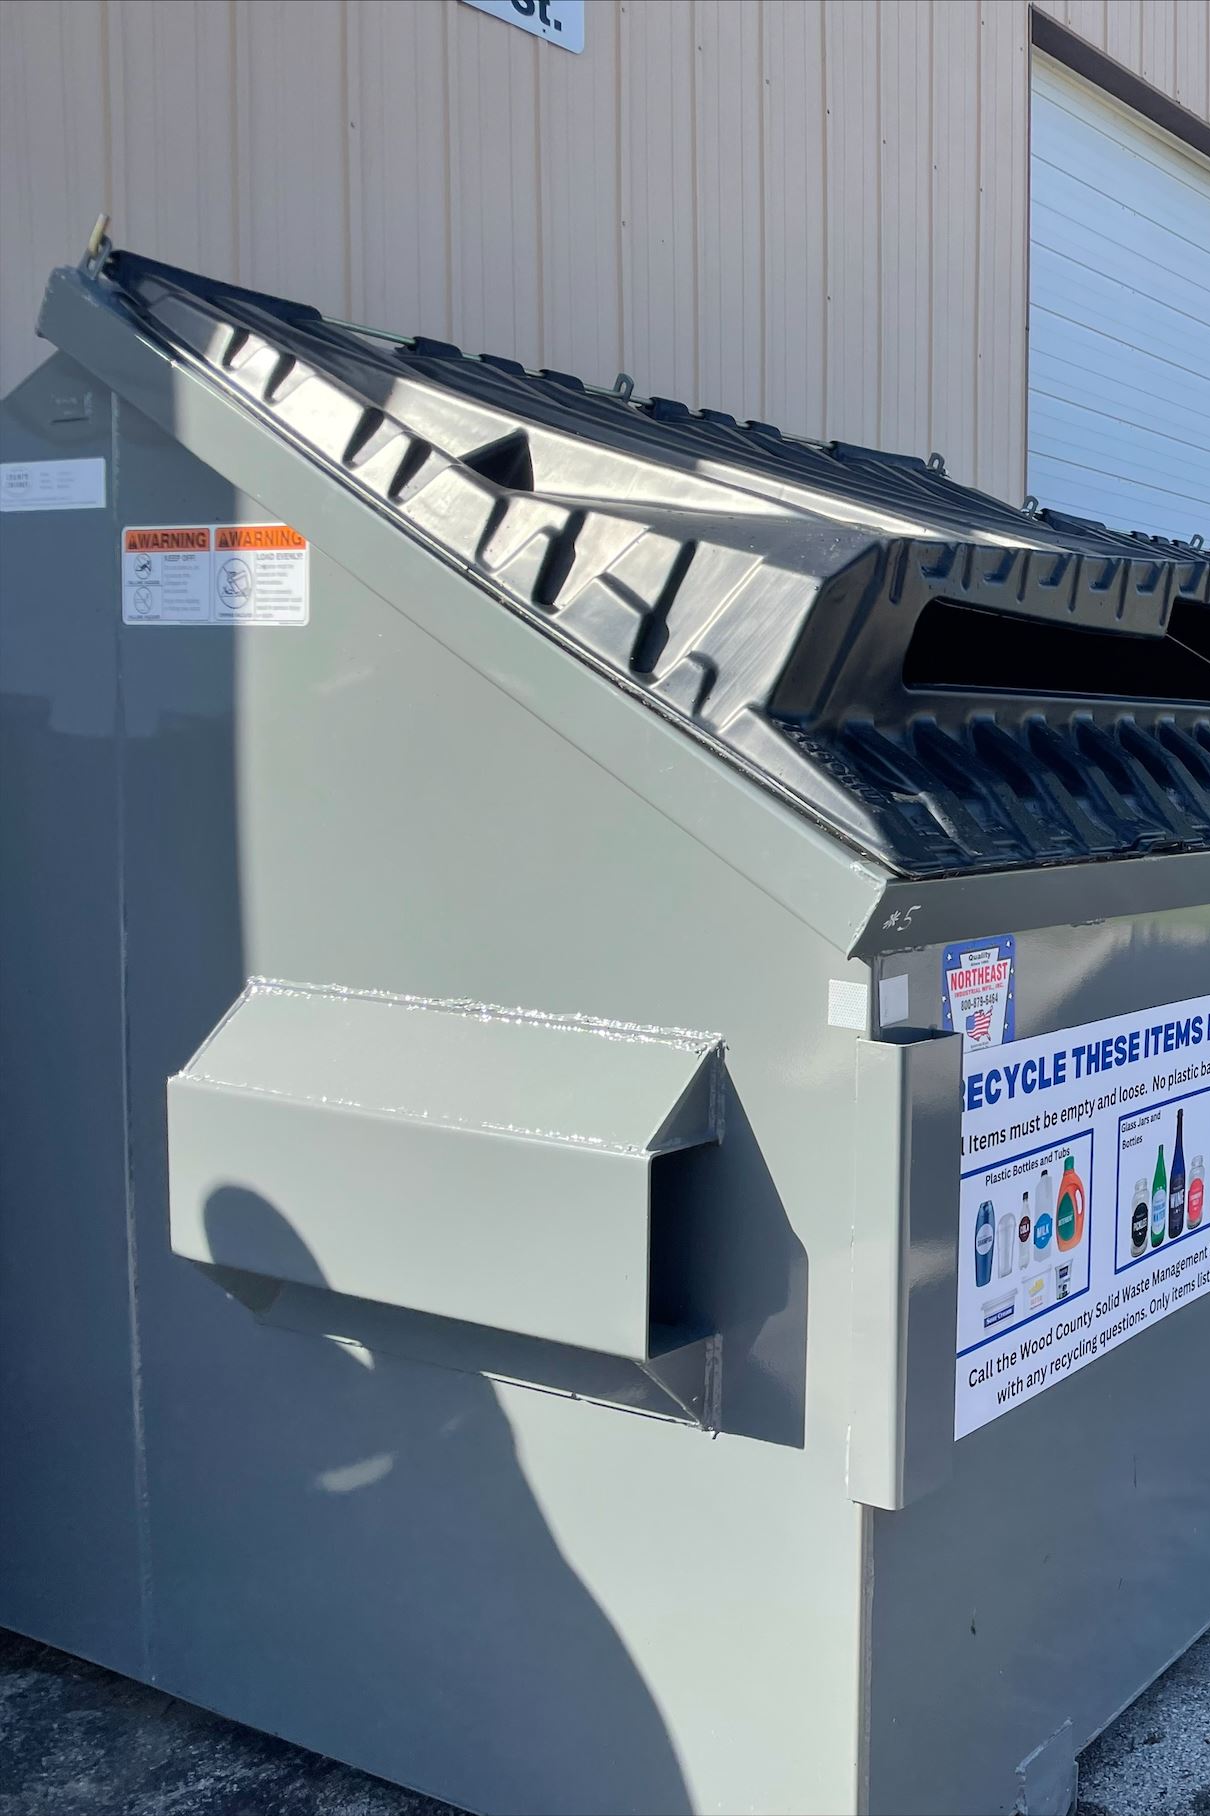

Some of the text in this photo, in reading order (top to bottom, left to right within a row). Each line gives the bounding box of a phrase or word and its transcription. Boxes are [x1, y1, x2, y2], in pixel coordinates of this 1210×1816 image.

[138, 532, 206, 549] WARNING
[229, 530, 302, 547] WARNING
[968, 951, 991, 961] Quality
[950, 962, 1008, 991] NORTHEAST
[955, 988, 981, 998] INDUSTRIAL
[1072, 1031, 1140, 1079] THESE
[1144, 1016, 1203, 1059] ITEMS
[969, 1128, 1006, 1153] Items
[1010, 1115, 1041, 1141] must
[1043, 1110, 1058, 1130] be
[1060, 1097, 1096, 1123] empty
[1097, 1088, 1117, 1111] and
[1119, 1082, 1148, 1103] loose.
[1152, 1075, 1166, 1092] No
[1168, 1064, 1198, 1091] plastic
[1121, 1111, 1161, 1133] Glass Jars and
[1121, 1135, 1143, 1150] Bottles
[986, 1147, 1070, 1186] Plastic Bottles and Tubs
[1037, 1223, 1049, 1238] MILK
[968, 1360, 993, 1388] Call
[996, 1352, 1017, 1373] the
[1020, 1328, 1053, 1360] Wood
[1056, 1313, 1094, 1340] County
[1096, 1290, 1120, 1318] Solid
[1122, 1279, 1150, 1303] Waste
[1152, 1247, 1208, 1287] Management
[997, 1376, 1024, 1404] with
[1026, 1366, 1048, 1388] any
[1050, 1336, 1098, 1375] recycling
[1099, 1307, 1147, 1350] questions.
[1149, 1291, 1170, 1315] Only
[1171, 1279, 1195, 1303] items
